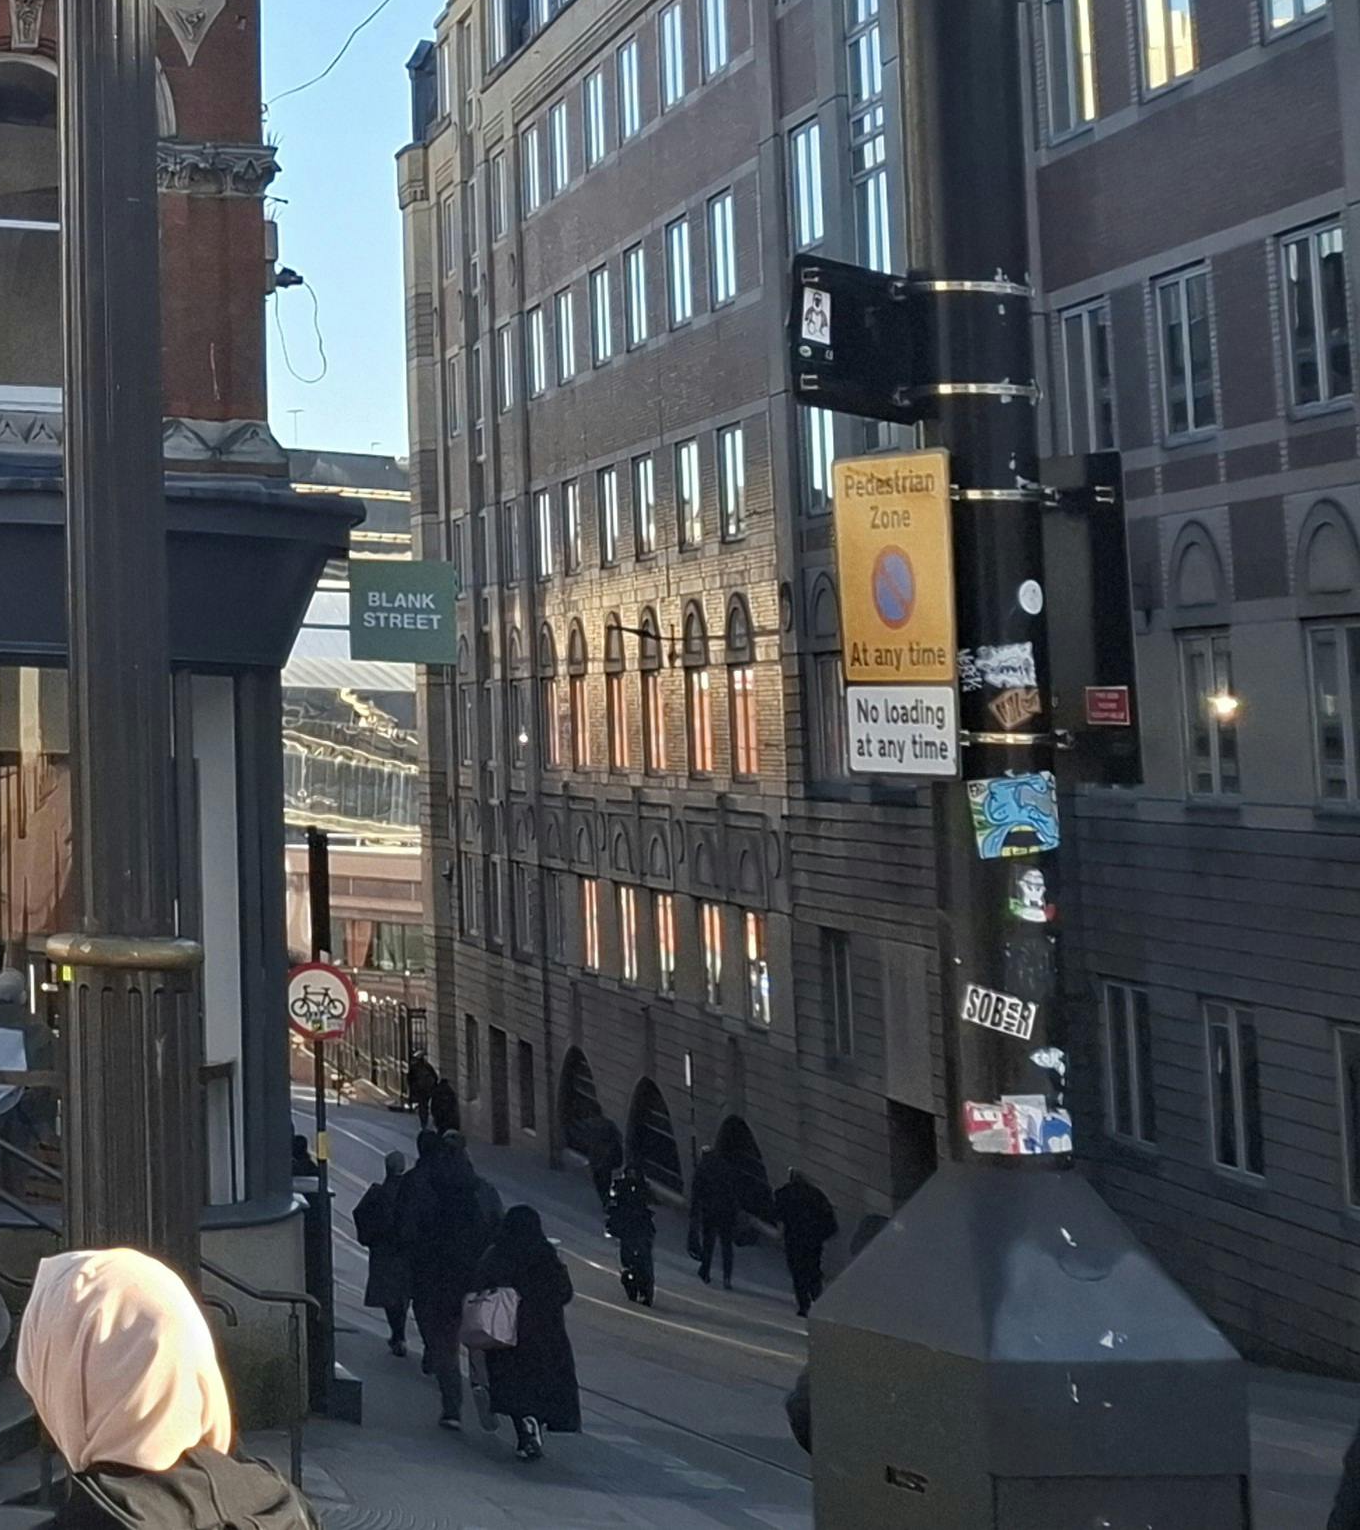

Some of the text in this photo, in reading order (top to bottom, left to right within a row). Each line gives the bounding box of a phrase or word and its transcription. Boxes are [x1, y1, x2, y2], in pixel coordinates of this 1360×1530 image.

[844, 470, 935, 498] Pedestrian
[870, 505, 911, 529] Zone
[367, 591, 436, 609] BLANK
[363, 612, 442, 629] STREET
[850, 641, 946, 671] At any time
[856, 699, 945, 730] No loading
[856, 733, 949, 763] at any time
